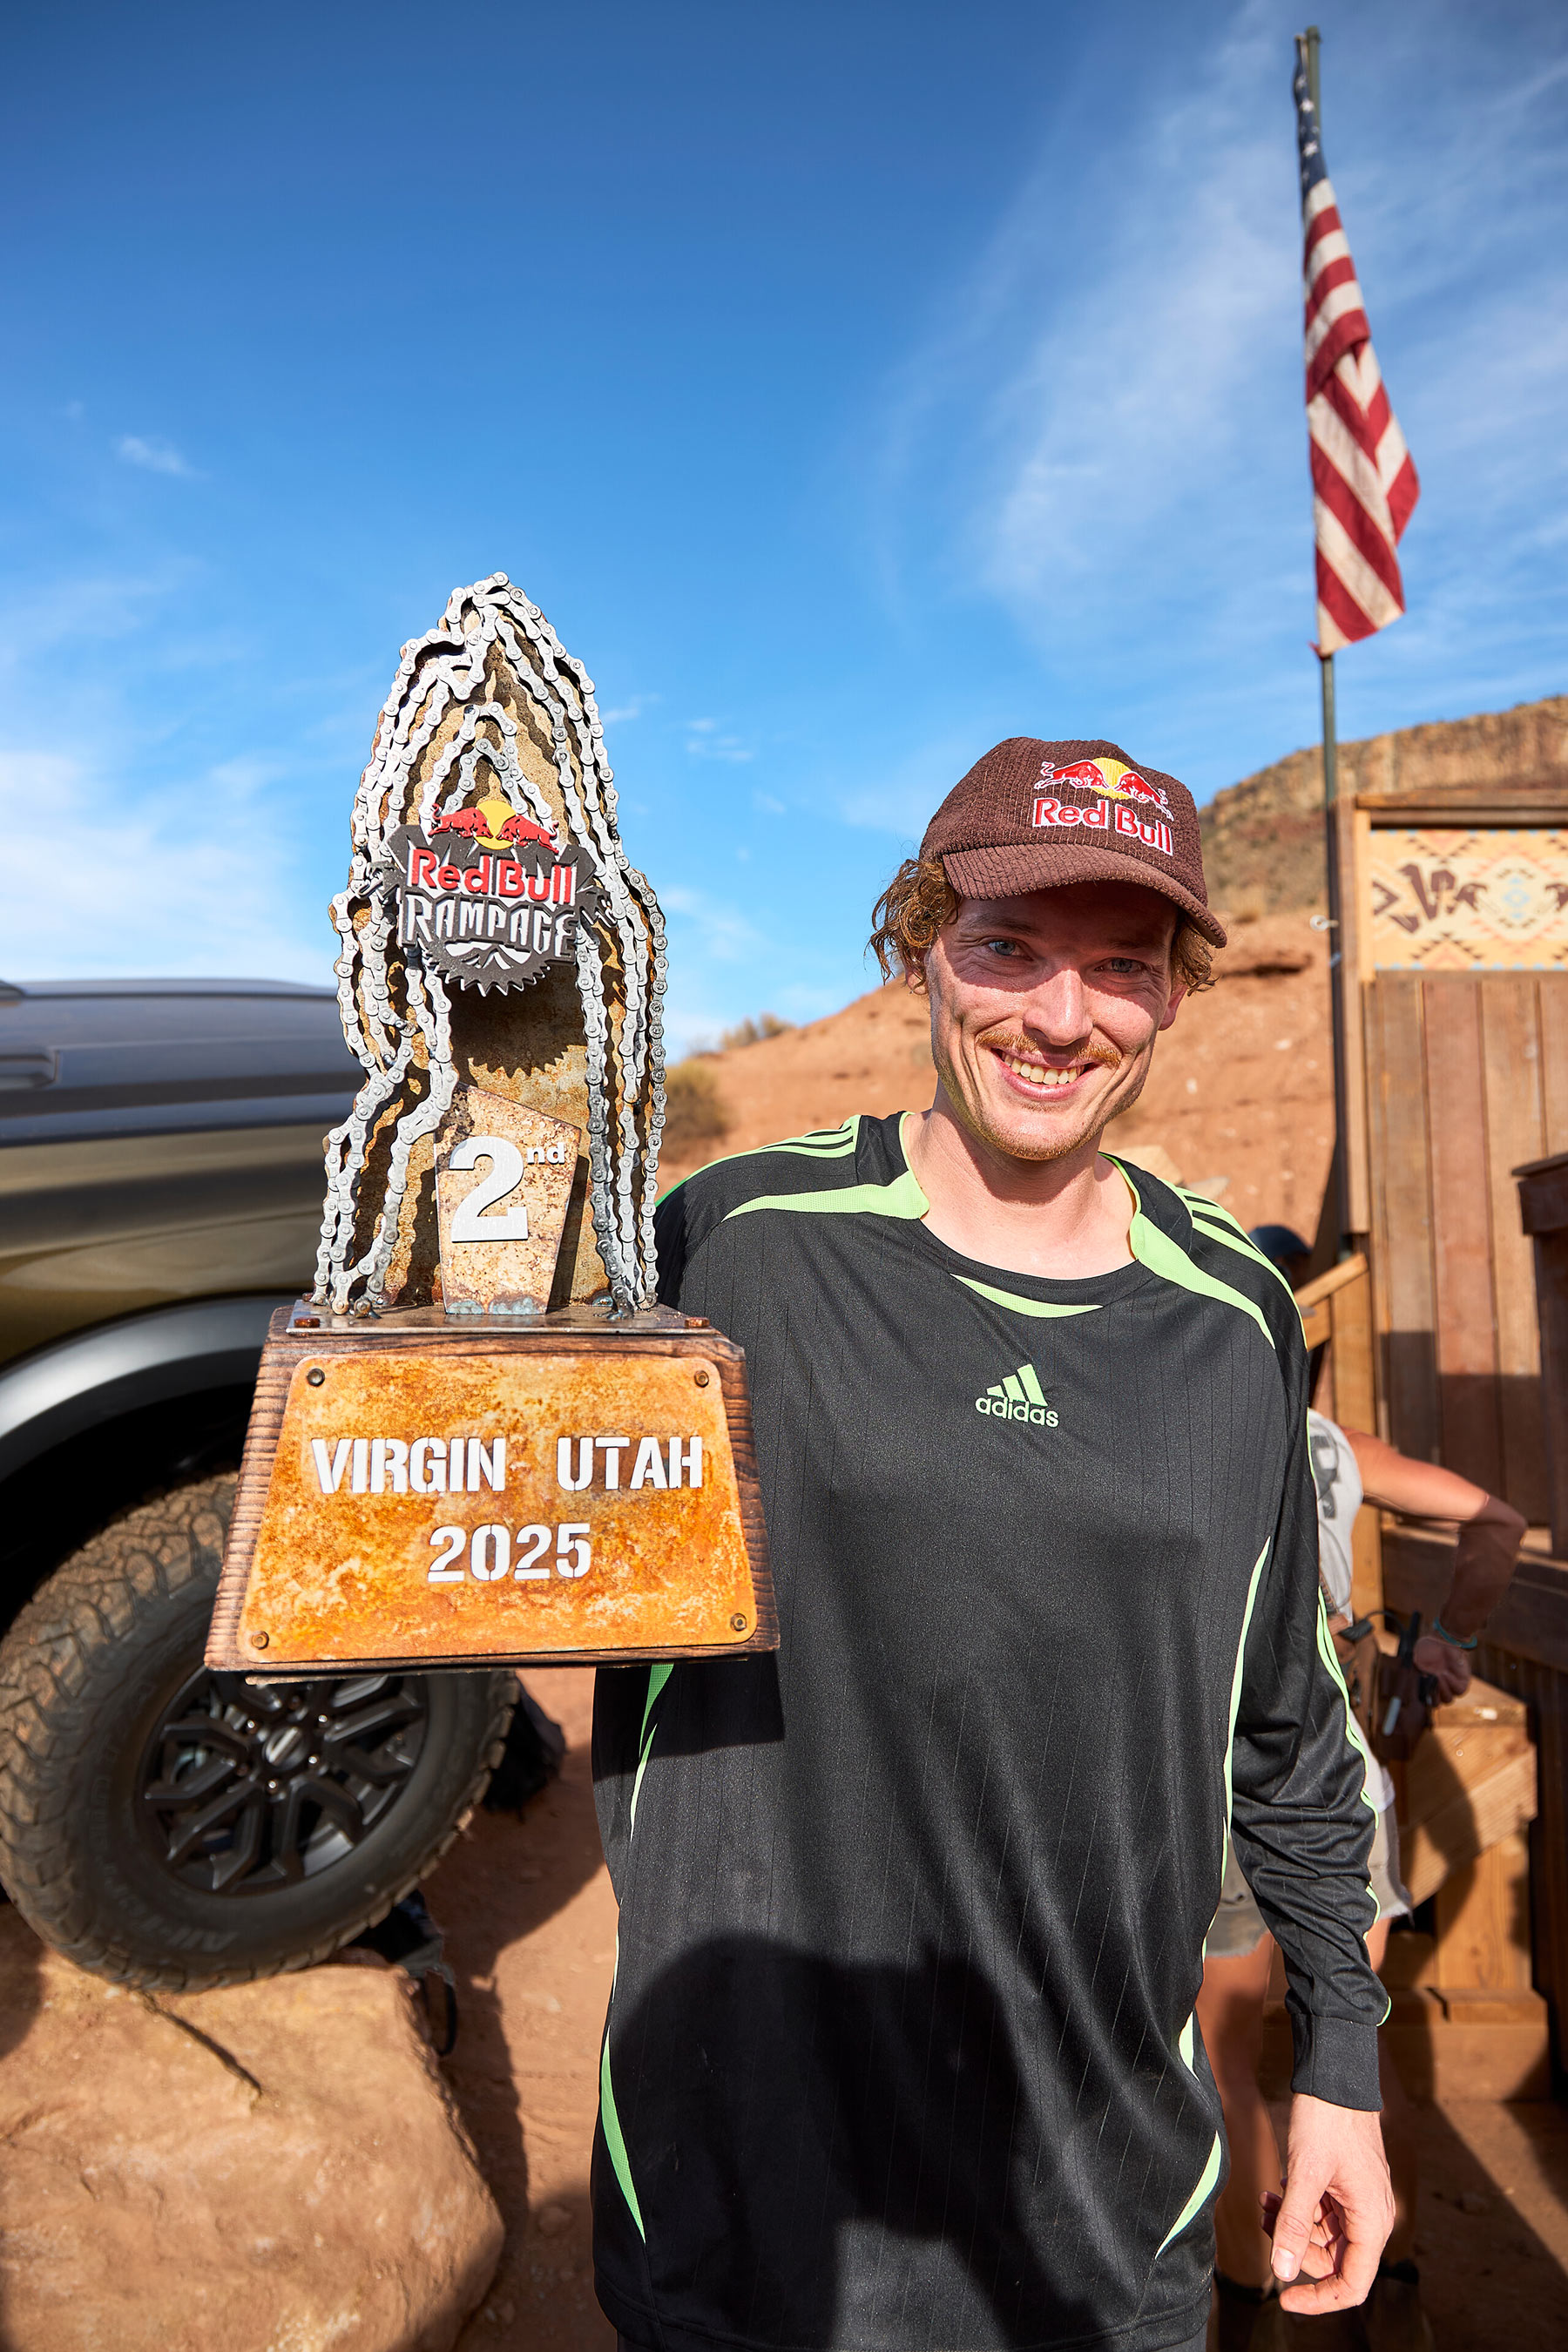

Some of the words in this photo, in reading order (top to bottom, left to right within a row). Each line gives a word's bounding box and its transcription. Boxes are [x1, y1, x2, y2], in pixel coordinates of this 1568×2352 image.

[1032, 797, 1109, 829] Red
[1115, 803, 1173, 856] Bull
[410, 848, 490, 895] Red
[498, 859, 572, 903] Bull
[403, 892, 576, 959] RAMPAGE
[976, 1396, 1059, 1428] adidas
[311, 1436, 506, 1494] VIRGIN
[557, 1436, 703, 1492] UTAH
[427, 1523, 591, 1582] 2025
